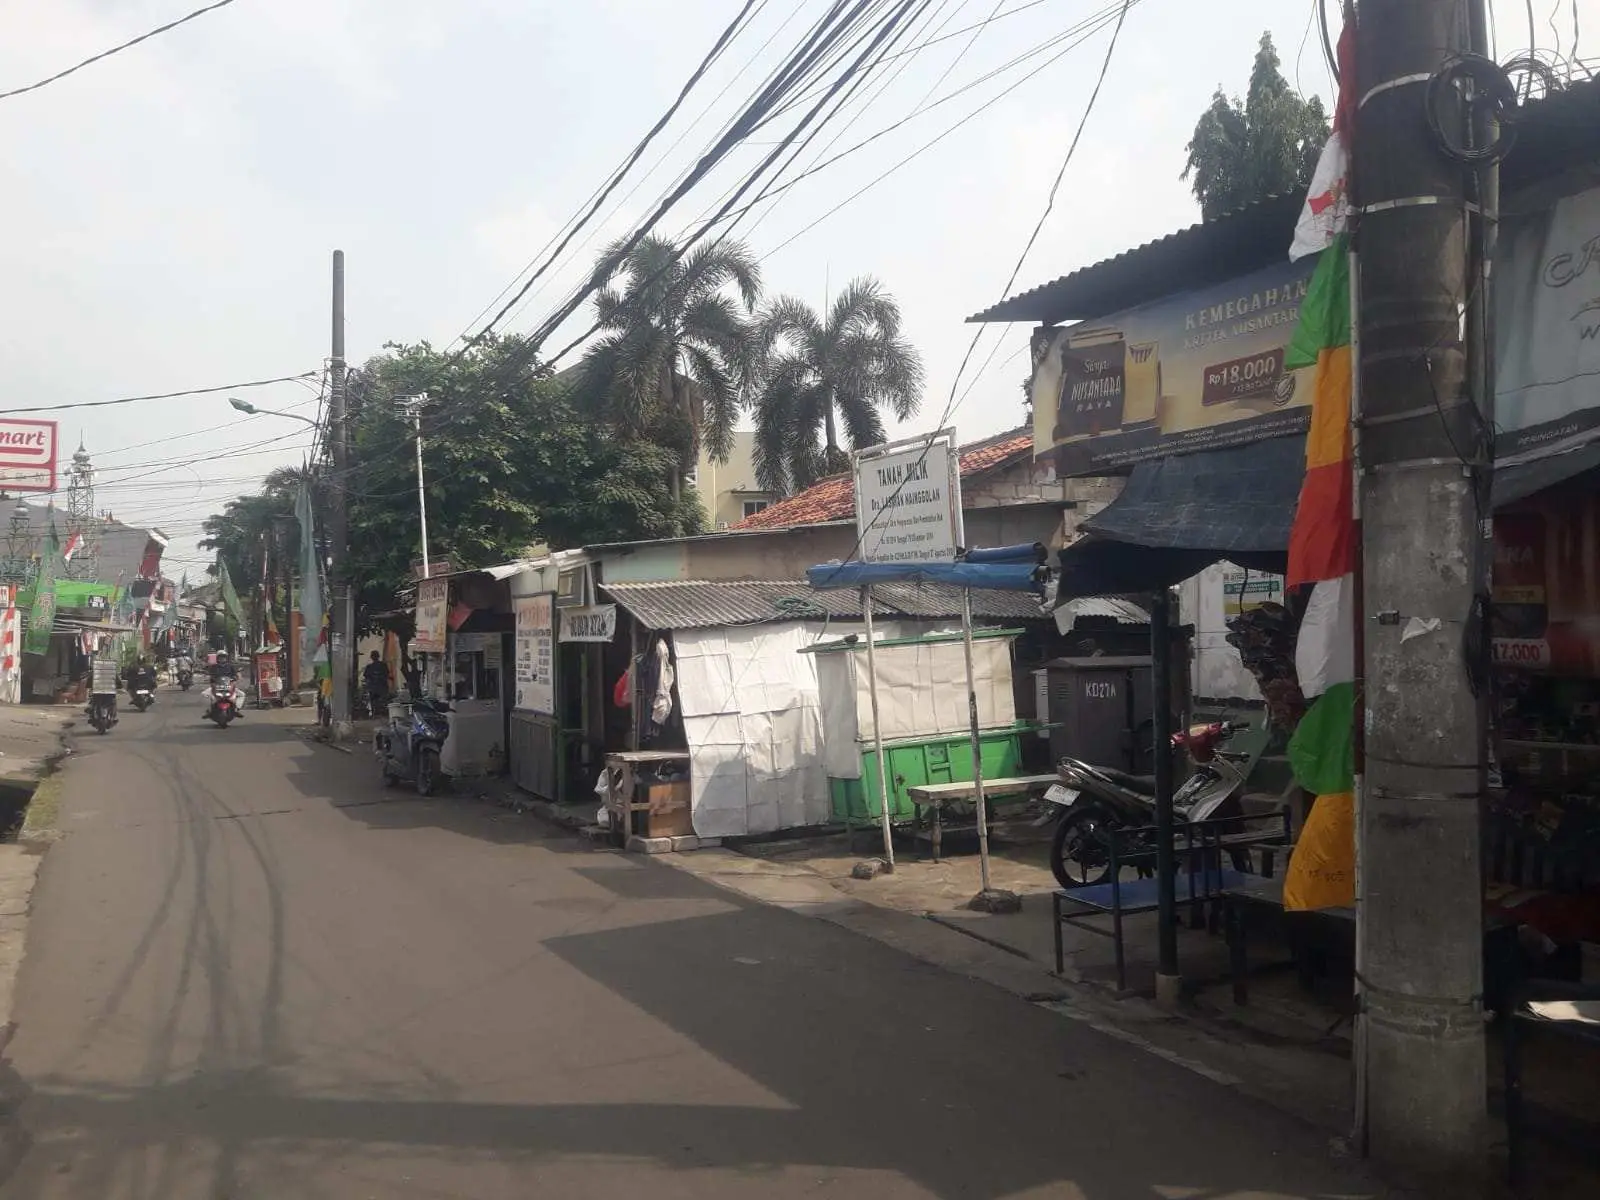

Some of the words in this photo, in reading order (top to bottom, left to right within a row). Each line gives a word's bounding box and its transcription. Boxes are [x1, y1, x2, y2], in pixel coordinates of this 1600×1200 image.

[1184, 278, 1308, 332] KEMEGAHAN
[1231, 307, 1300, 336] NUSANTAR
[878, 464, 902, 486] TANAH
